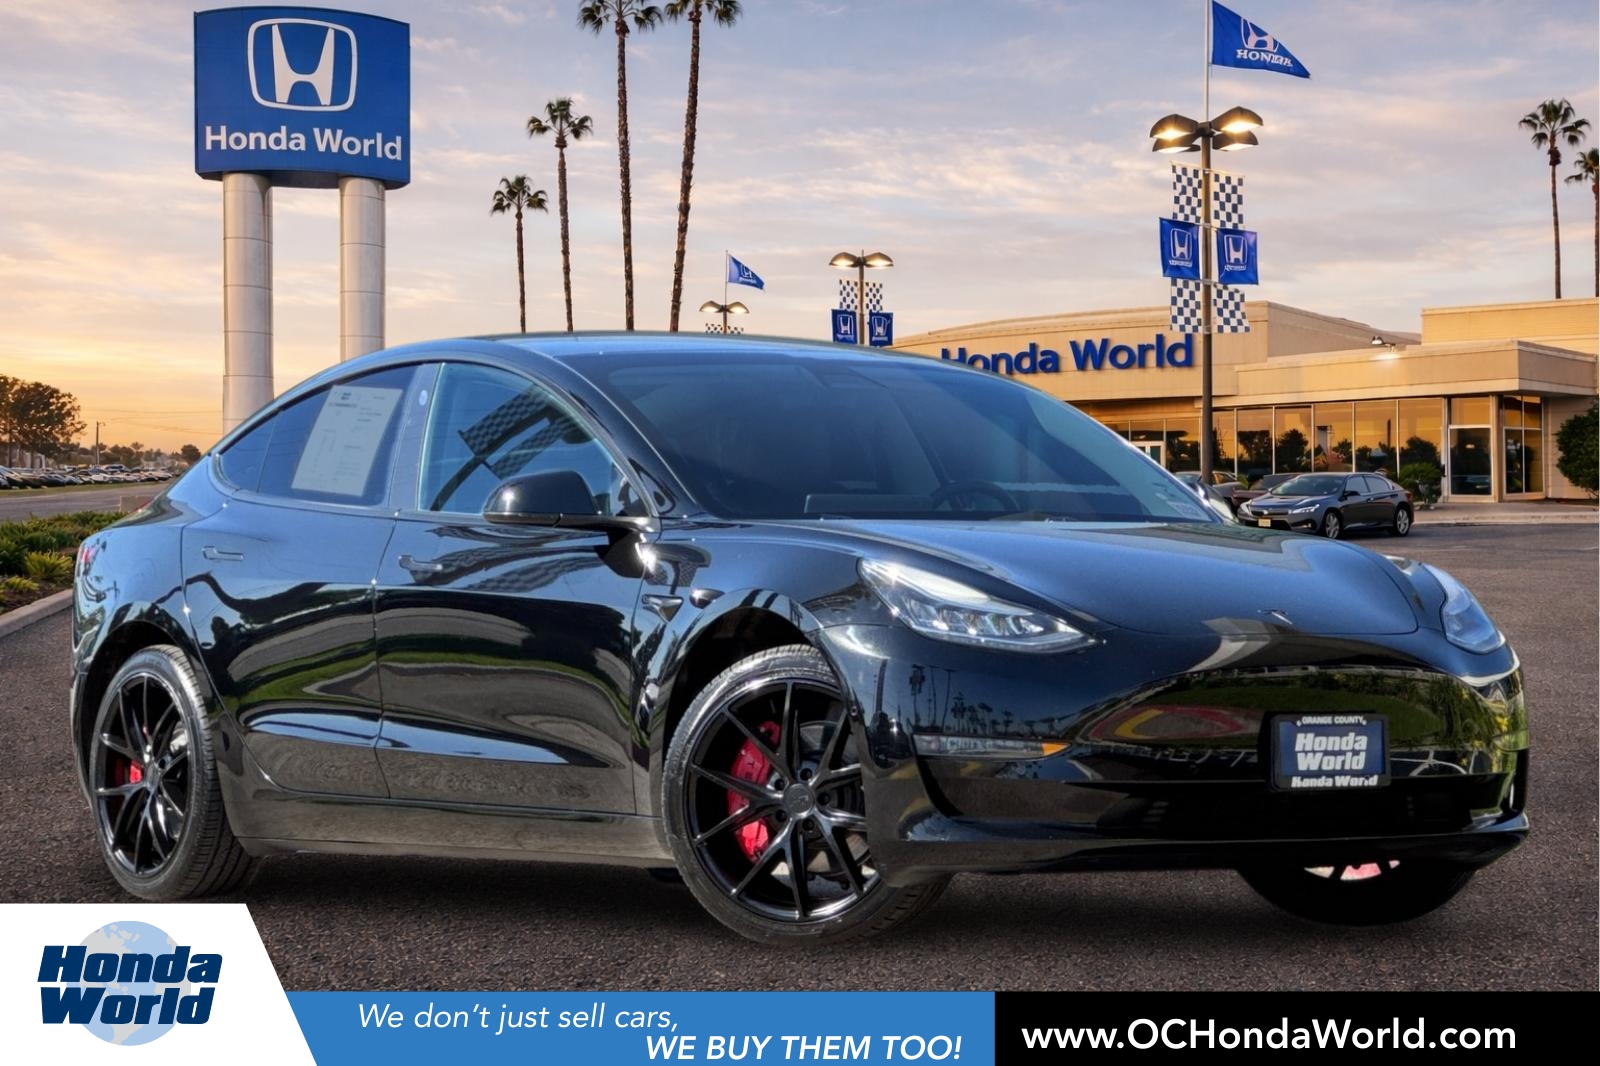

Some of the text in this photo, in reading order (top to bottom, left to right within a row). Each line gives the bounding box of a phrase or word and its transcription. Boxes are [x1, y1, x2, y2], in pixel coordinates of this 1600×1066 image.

[205, 125, 402, 161] Honda World
[1069, 333, 1193, 371] World
[1334, 715, 1363, 725] COUNTY
[1295, 732, 1368, 751] Honda
[1297, 751, 1366, 771] World
[1291, 776, 1333, 788] Honda
